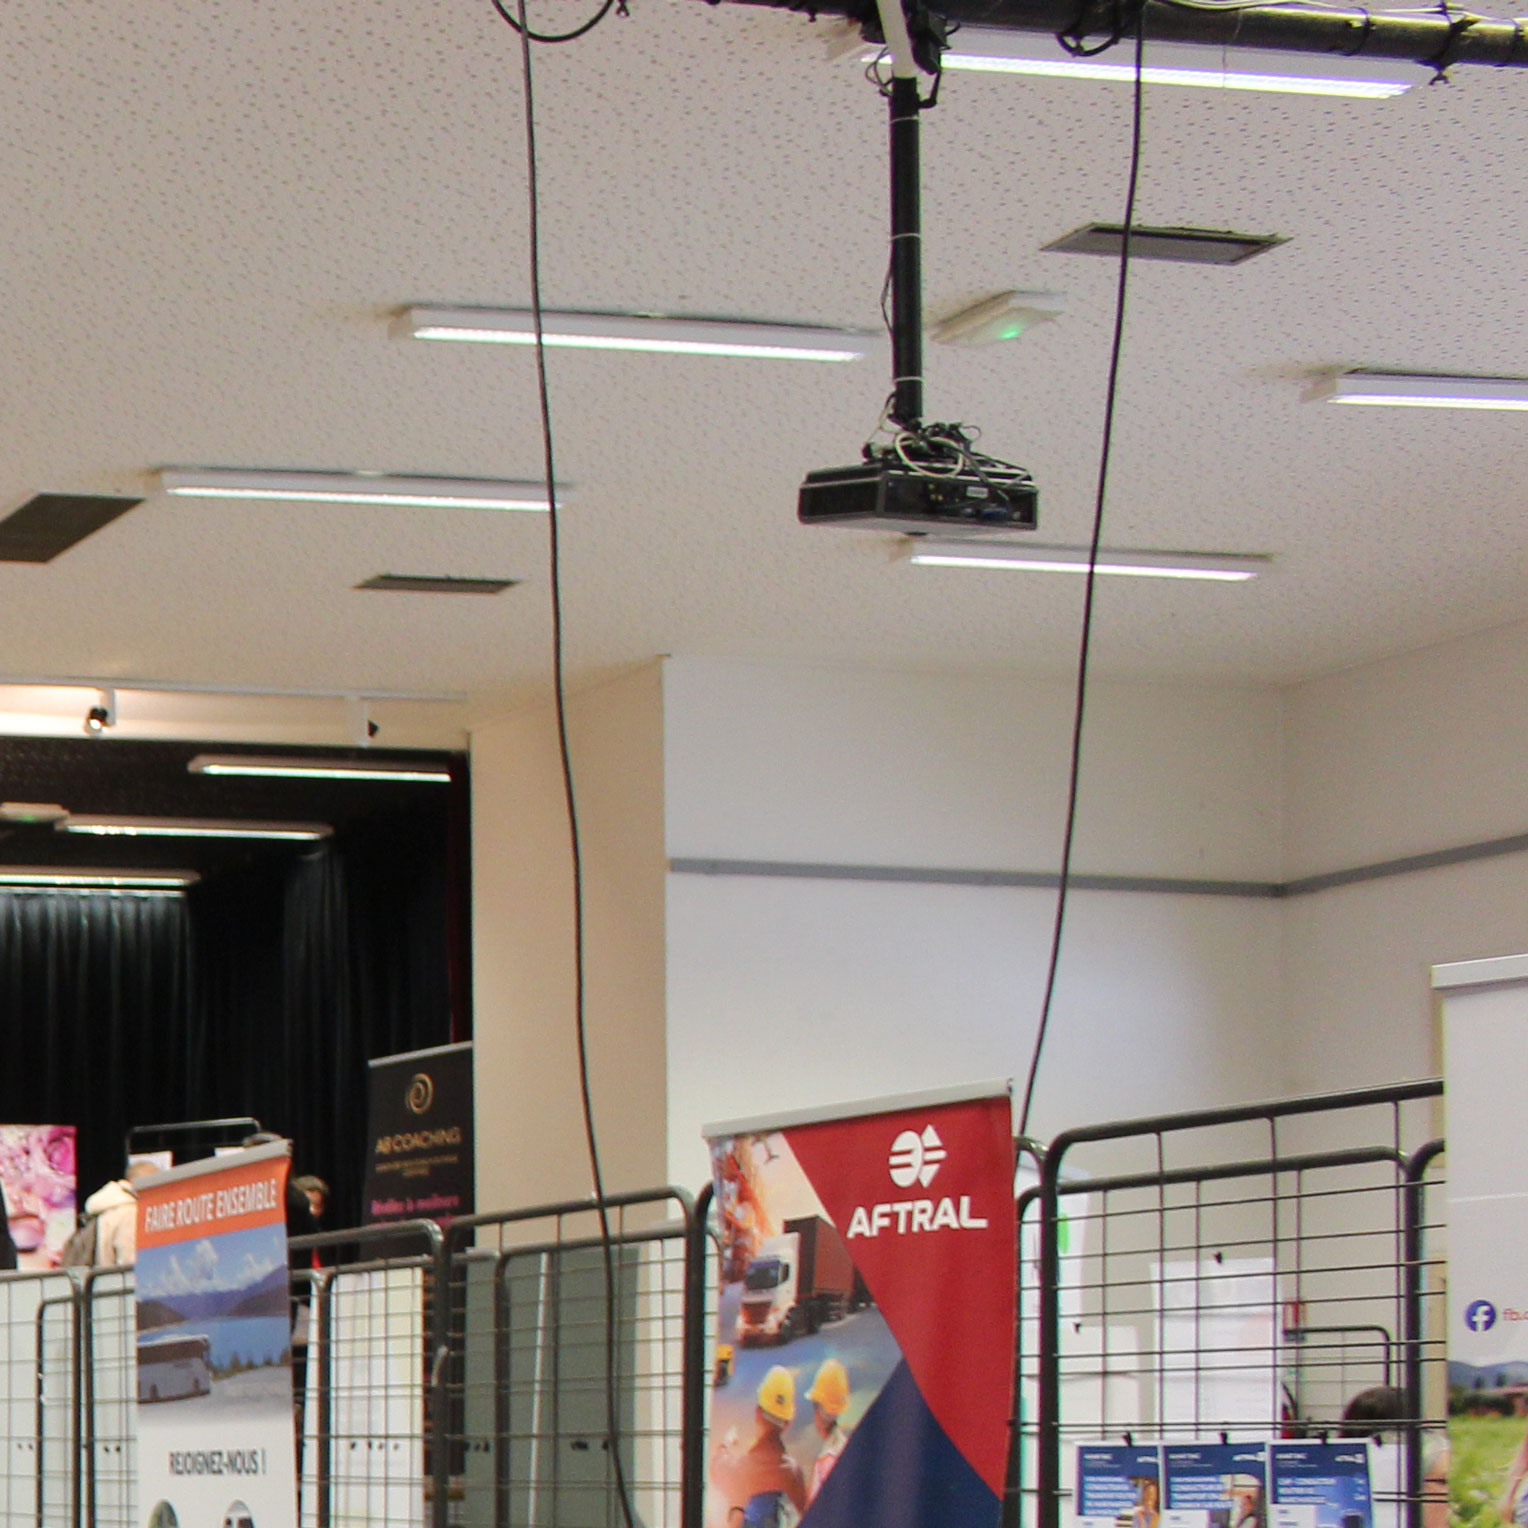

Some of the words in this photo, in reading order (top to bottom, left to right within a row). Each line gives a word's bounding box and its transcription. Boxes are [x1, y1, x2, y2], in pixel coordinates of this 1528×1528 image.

[144, 1200, 176, 1233] FAIRE
[175, 1192, 215, 1227] ROUTE
[215, 1178, 278, 1219] ENSEMBLE
[846, 1196, 989, 1239] AFTRAL
